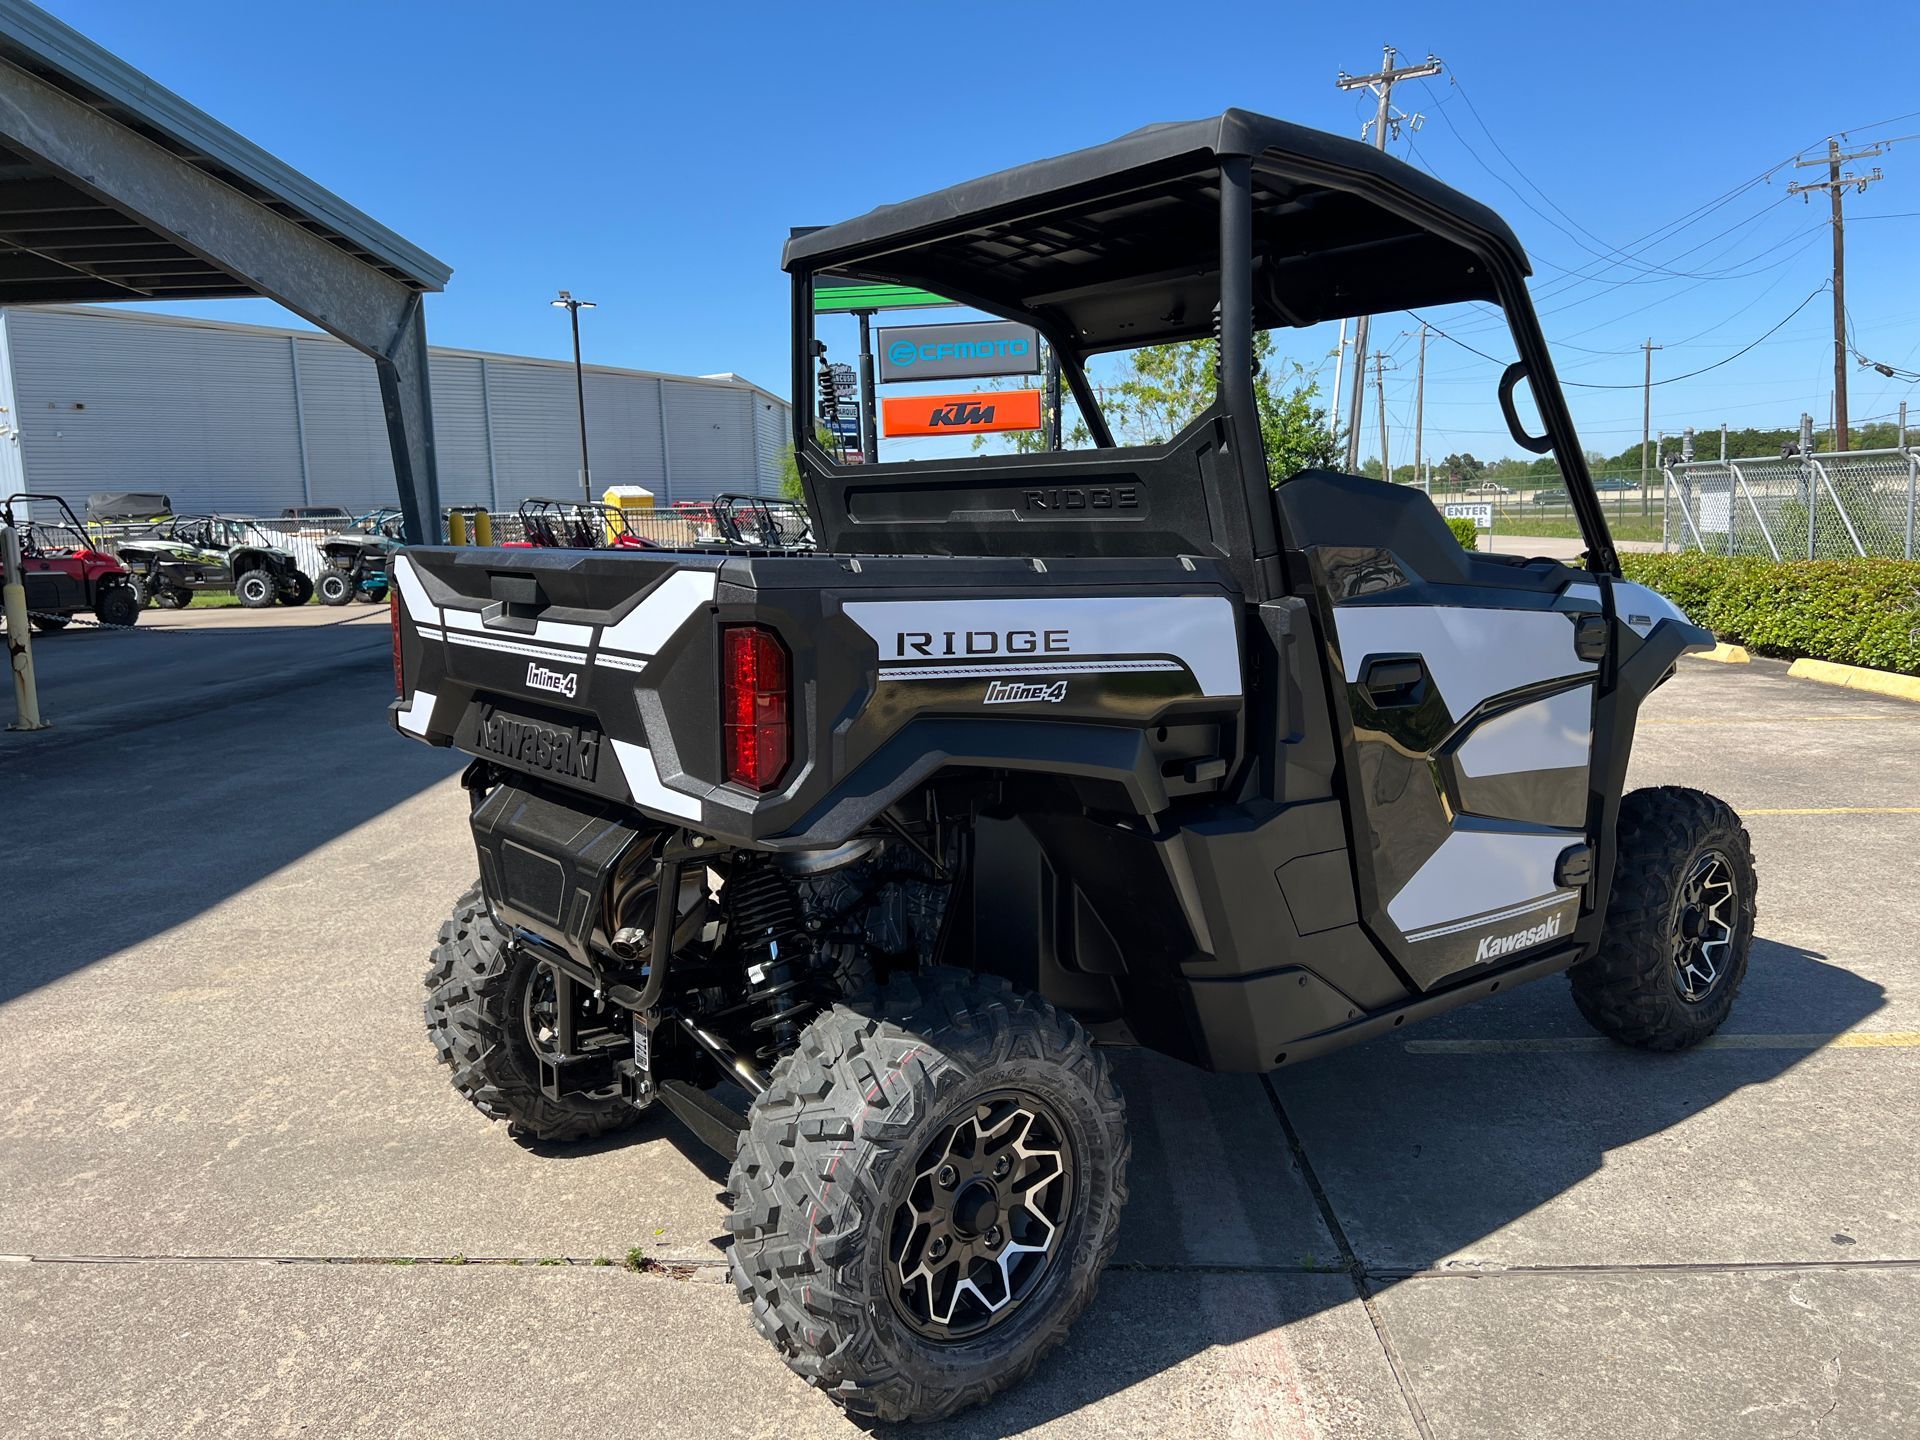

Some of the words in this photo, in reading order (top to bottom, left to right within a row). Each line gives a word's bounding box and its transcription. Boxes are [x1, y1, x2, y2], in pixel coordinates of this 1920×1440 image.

[918, 338, 1030, 362] CFMOTO
[928, 401, 995, 427] KTM
[1022, 487, 1141, 511] RIDGE
[1447, 506, 1488, 517] ENTER
[896, 629, 1071, 657] RIDGE
[526, 662, 578, 698] Inline-4
[983, 680, 1068, 705] Inline-4
[472, 700, 600, 783] Kawasaki
[1474, 912, 1562, 963] Kawasaki
